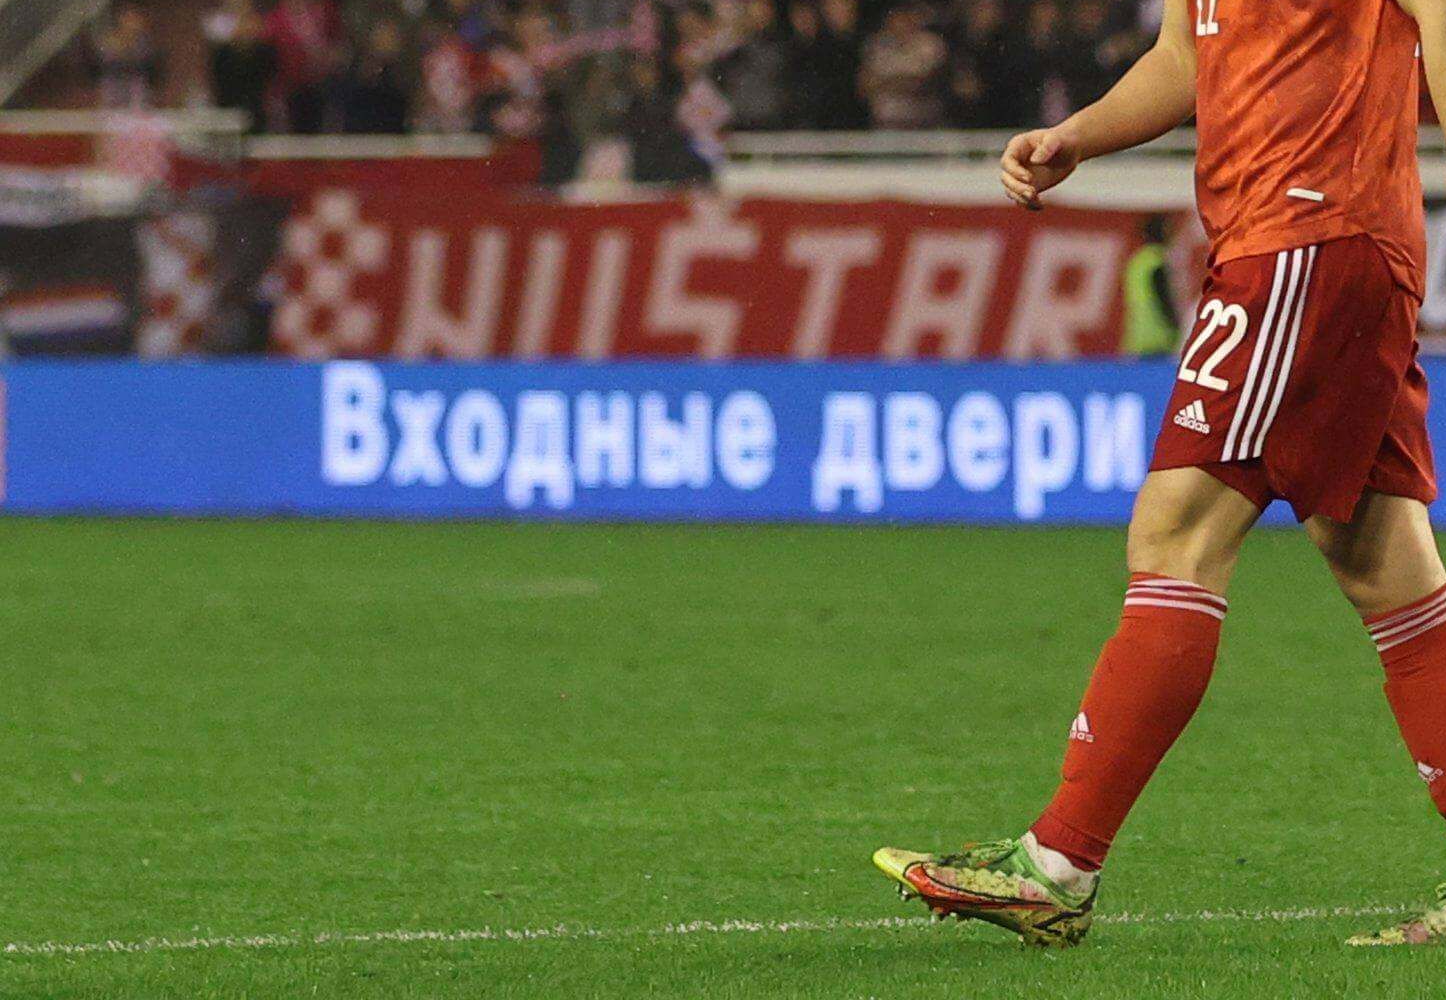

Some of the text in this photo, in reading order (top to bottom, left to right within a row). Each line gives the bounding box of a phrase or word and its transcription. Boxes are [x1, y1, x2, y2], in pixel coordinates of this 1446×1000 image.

[1177, 298, 1248, 392] 22
[319, 360, 1150, 520] Входные двери
[1173, 413, 1210, 435] adidas
